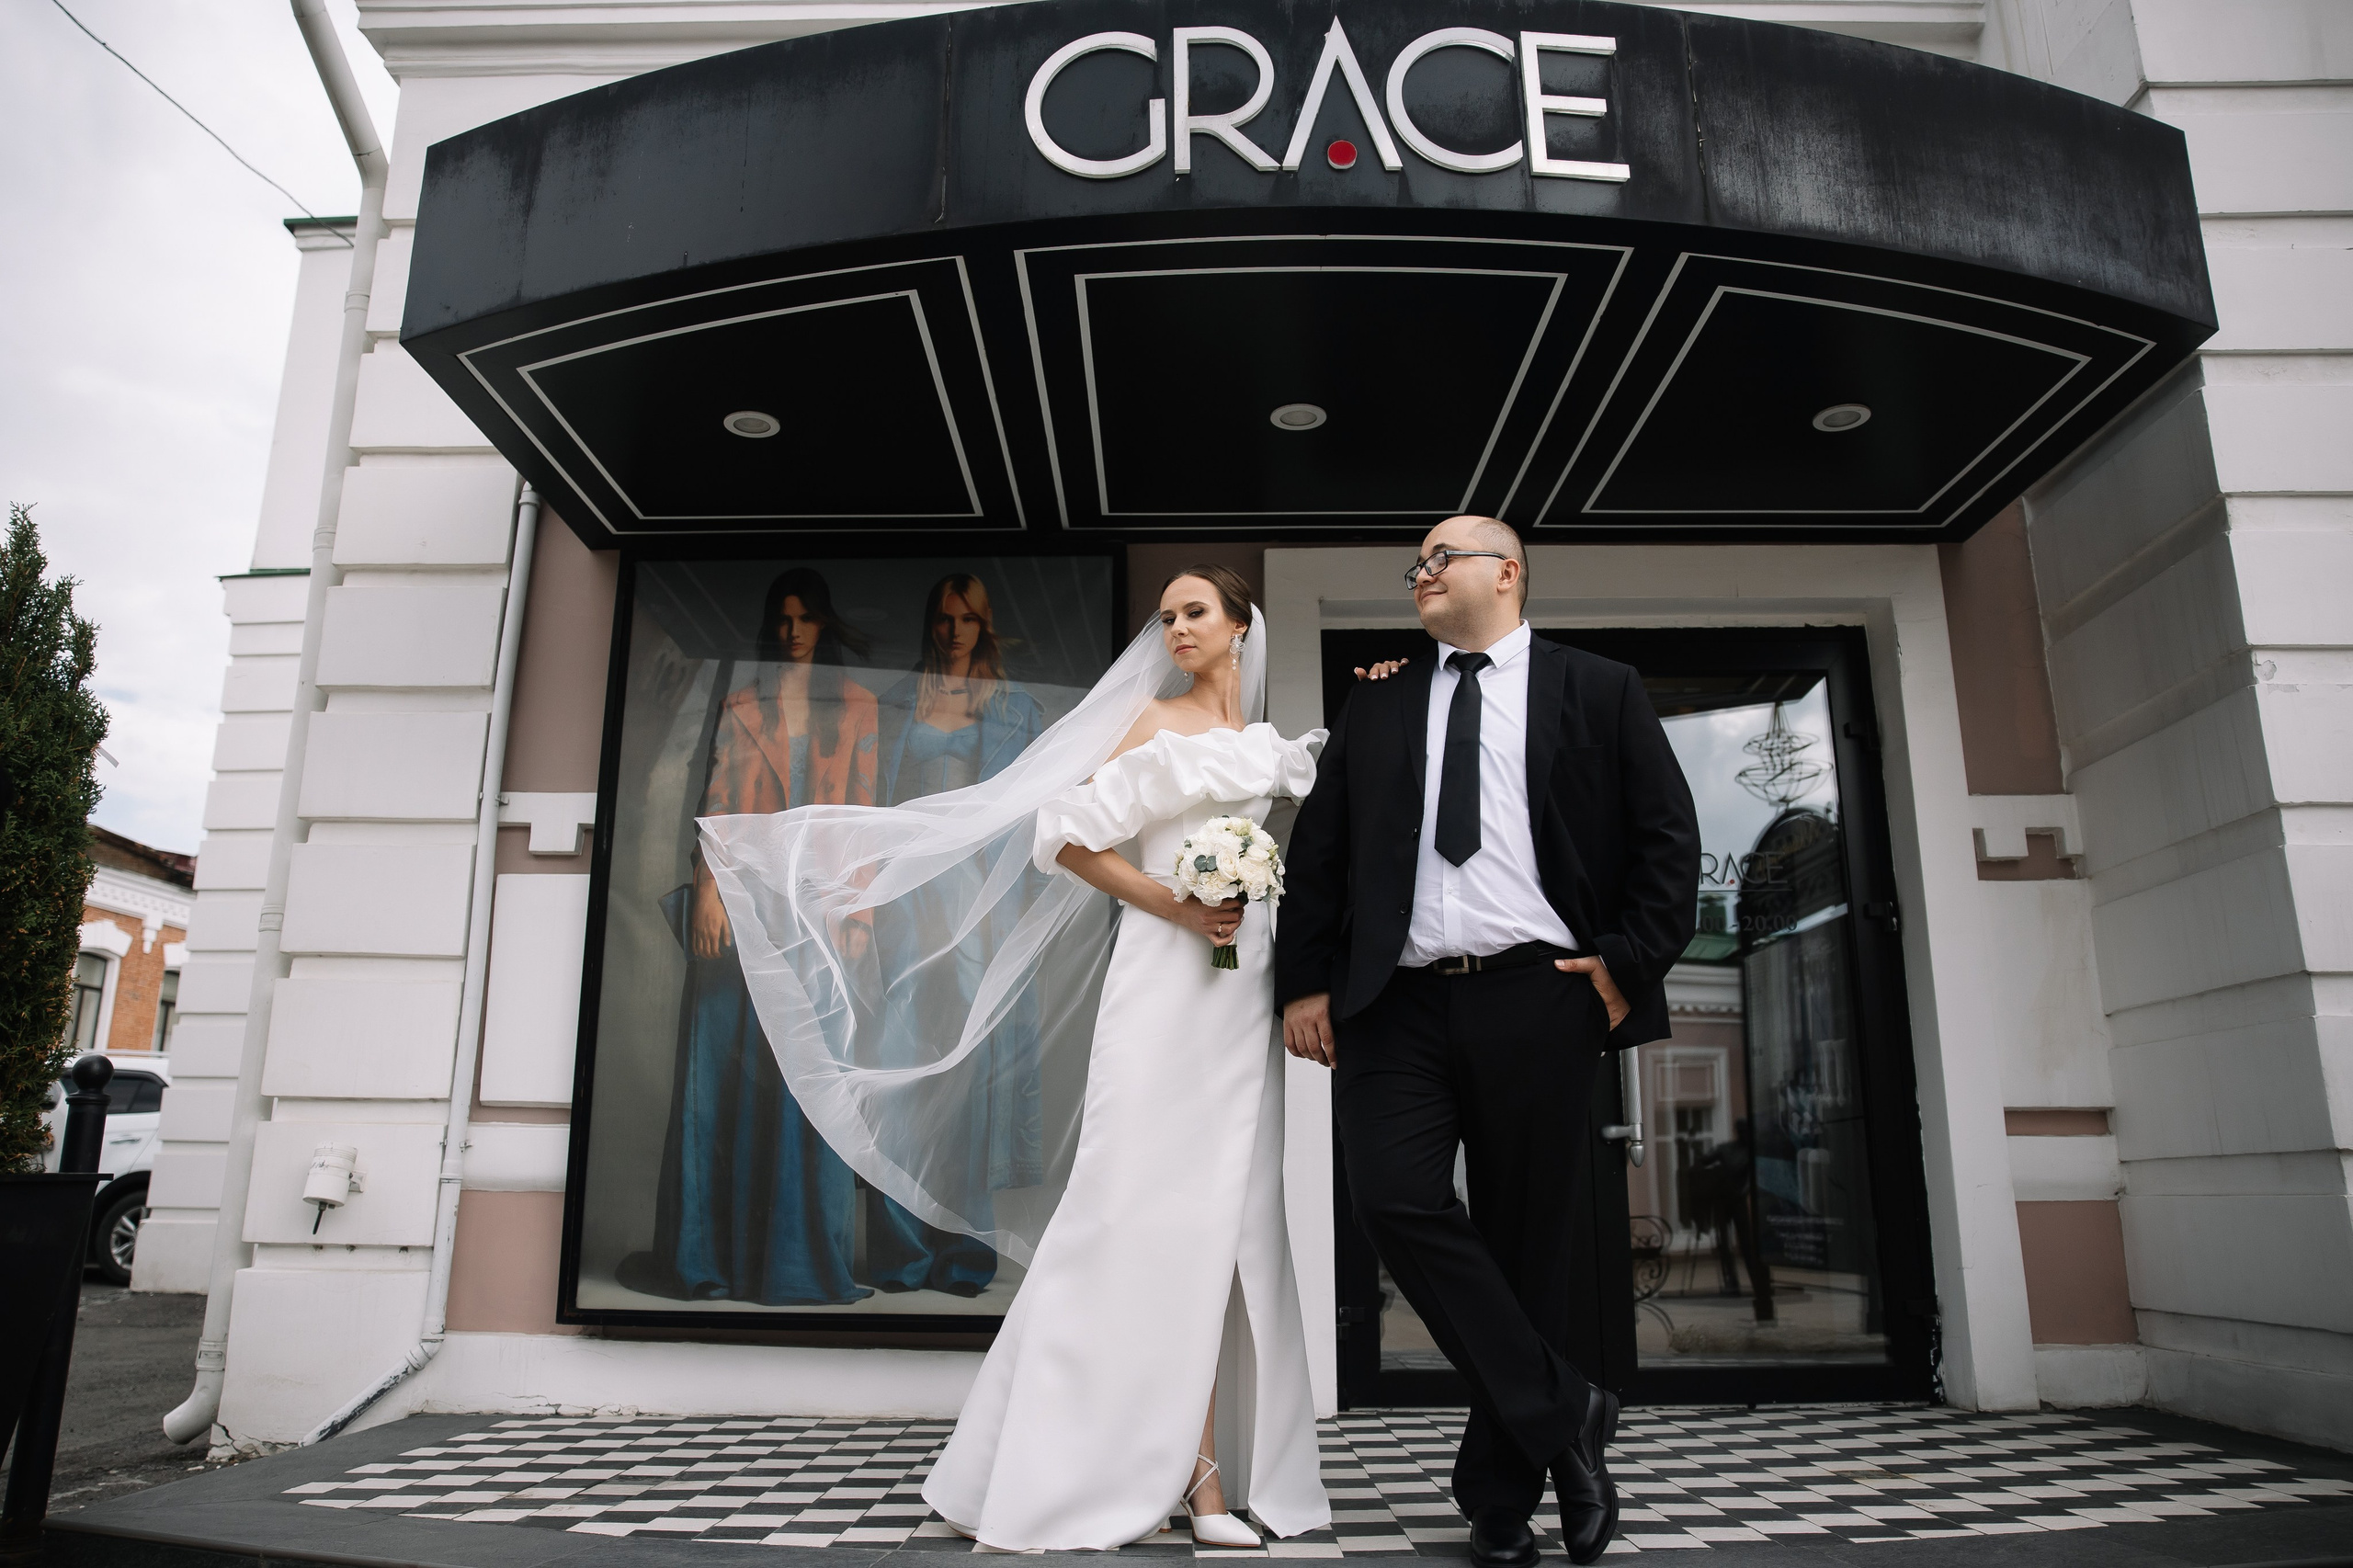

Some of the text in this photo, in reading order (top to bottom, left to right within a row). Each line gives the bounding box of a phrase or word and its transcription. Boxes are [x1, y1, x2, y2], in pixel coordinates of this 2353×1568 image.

[1025, 16, 1630, 182] GRACE
[1699, 851, 1789, 884] RACE
[1697, 915, 1725, 931] .00
[1742, 915, 1798, 931] 20.00
